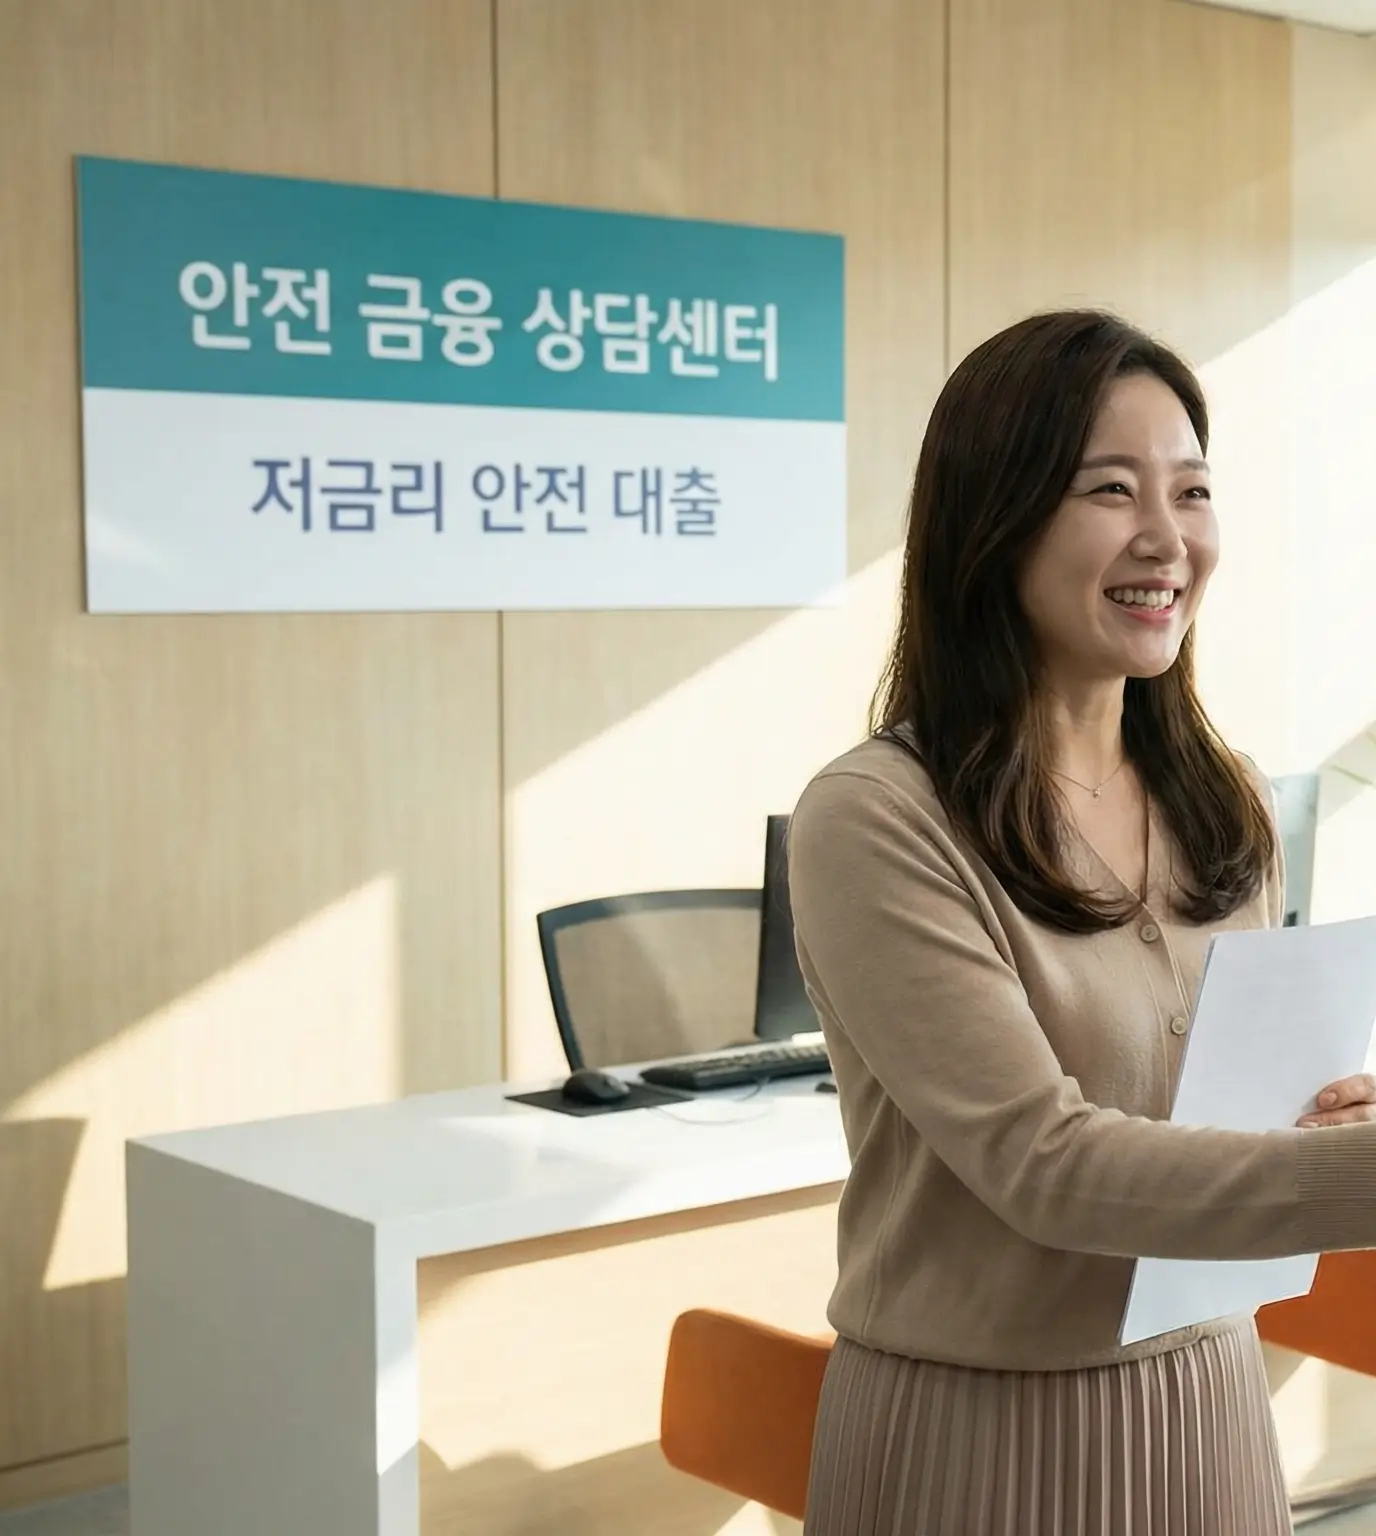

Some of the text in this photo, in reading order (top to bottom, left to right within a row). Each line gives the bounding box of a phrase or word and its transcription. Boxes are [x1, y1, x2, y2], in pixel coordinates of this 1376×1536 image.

[178, 261, 779, 381] 안전 금융 상담센터
[250, 455, 721, 537] 저금리 안전 대출
